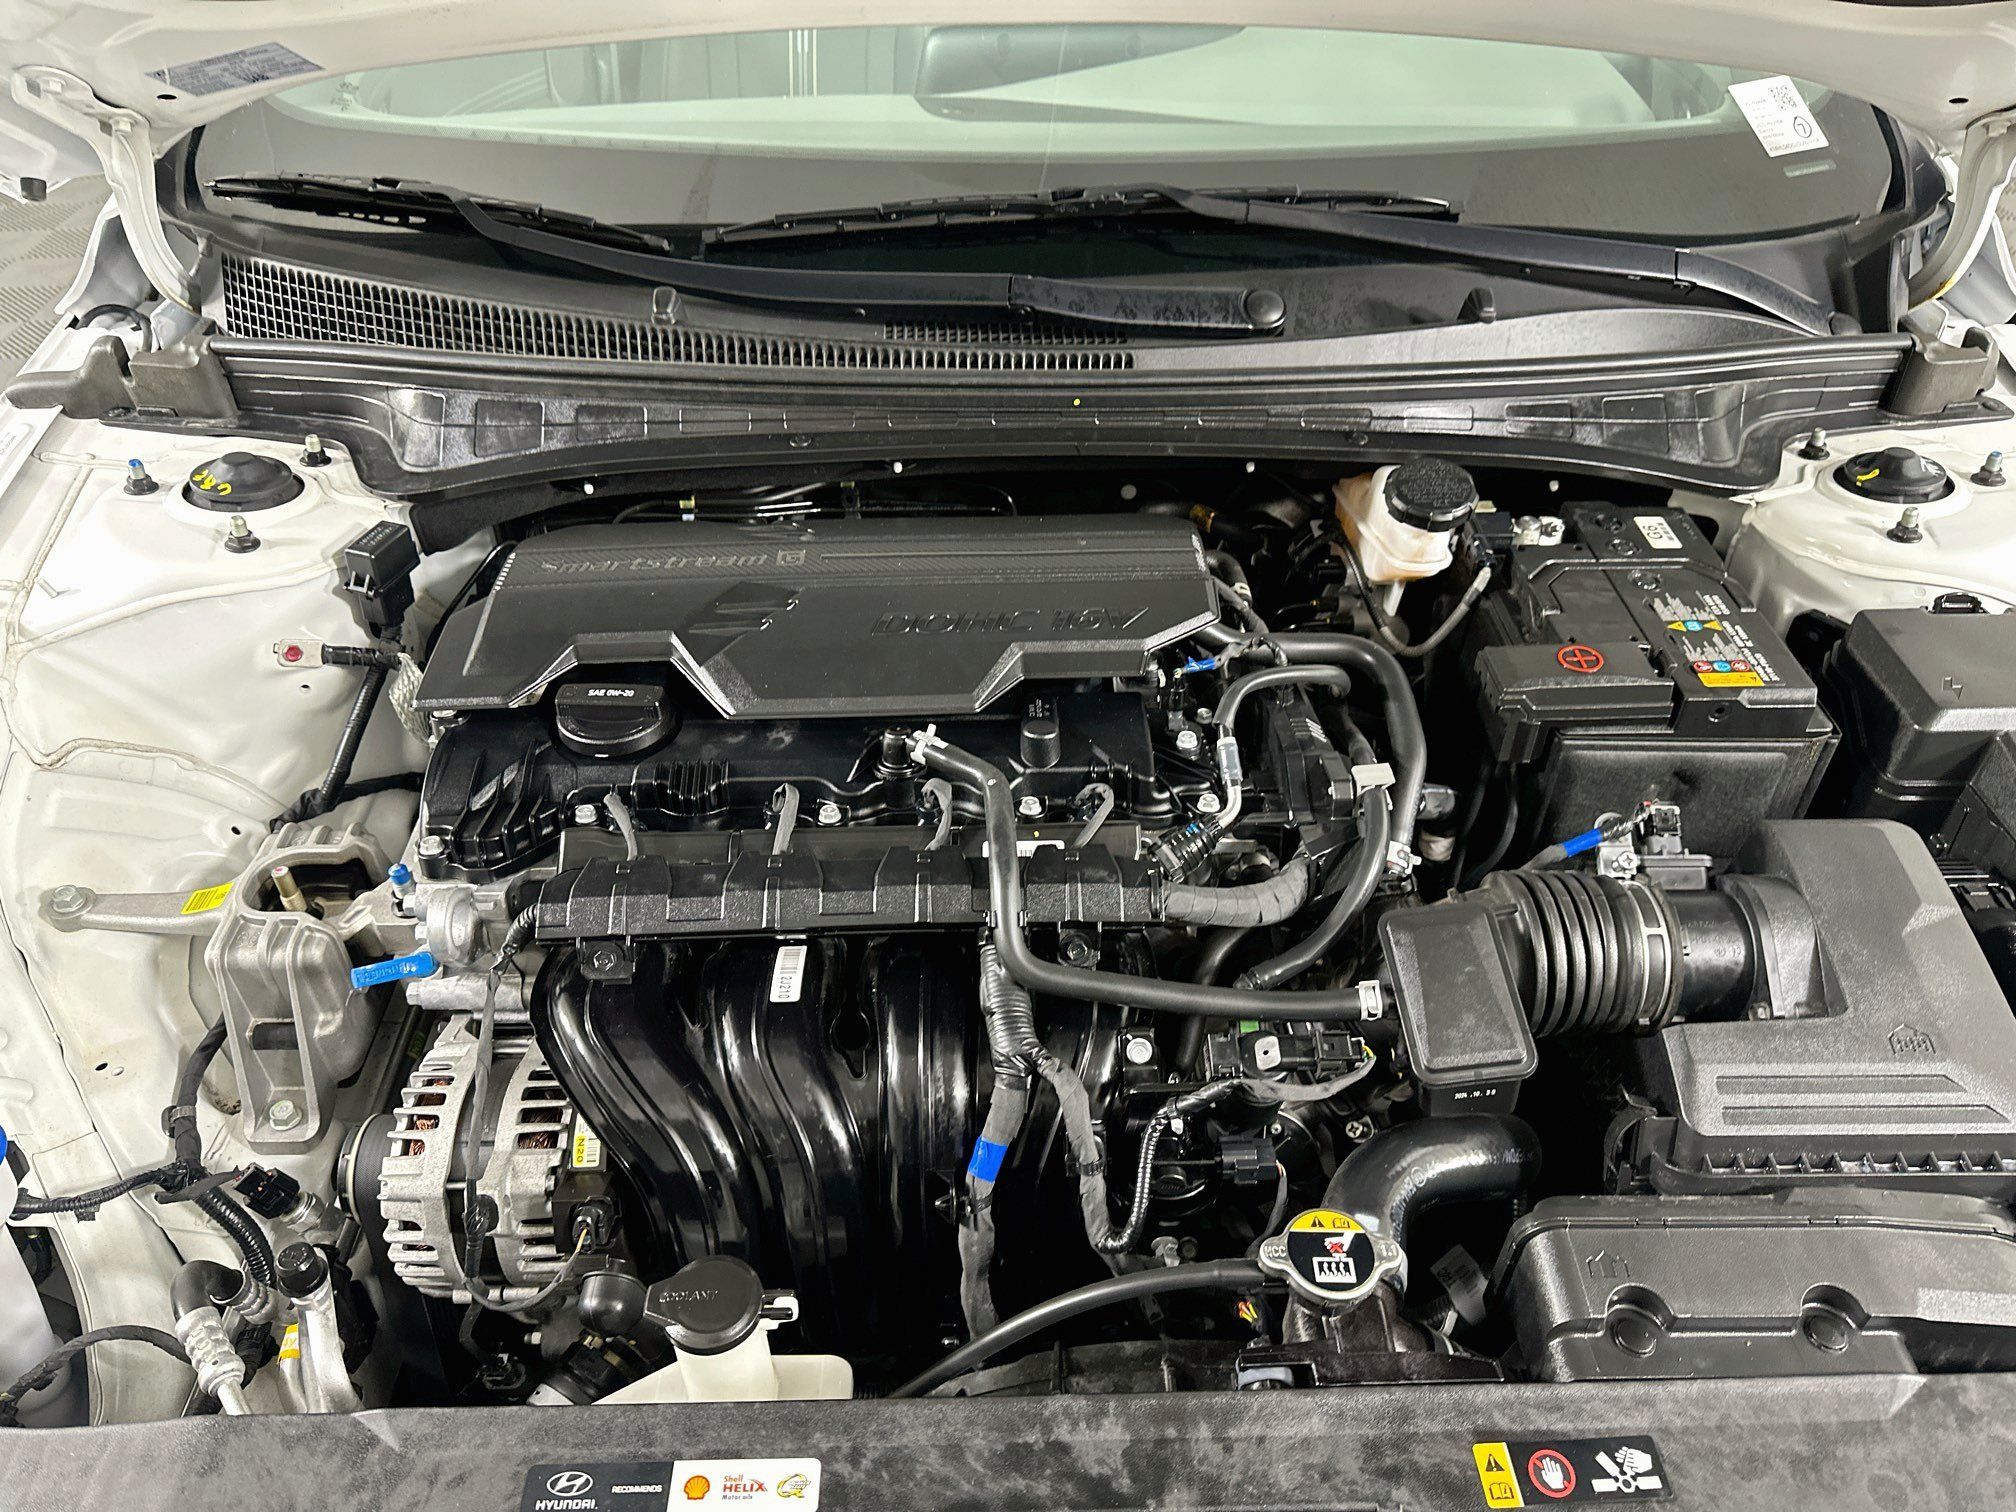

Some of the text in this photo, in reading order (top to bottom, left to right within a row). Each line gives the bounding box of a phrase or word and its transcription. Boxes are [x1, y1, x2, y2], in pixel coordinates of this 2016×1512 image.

[541, 554, 768, 574] Smartstream
[872, 606, 1149, 636] DOHC 16V
[587, 689, 635, 697] SAE 0W-20
[576, 1138, 586, 1163] N20
[1380, 1244, 1398, 1257] 1.1
[659, 1290, 719, 1303] COOLANT
[723, 1475, 744, 1483] Shell
[611, 1484, 663, 1494] RECOMMENDS
[722, 1482, 766, 1493] HELIX
